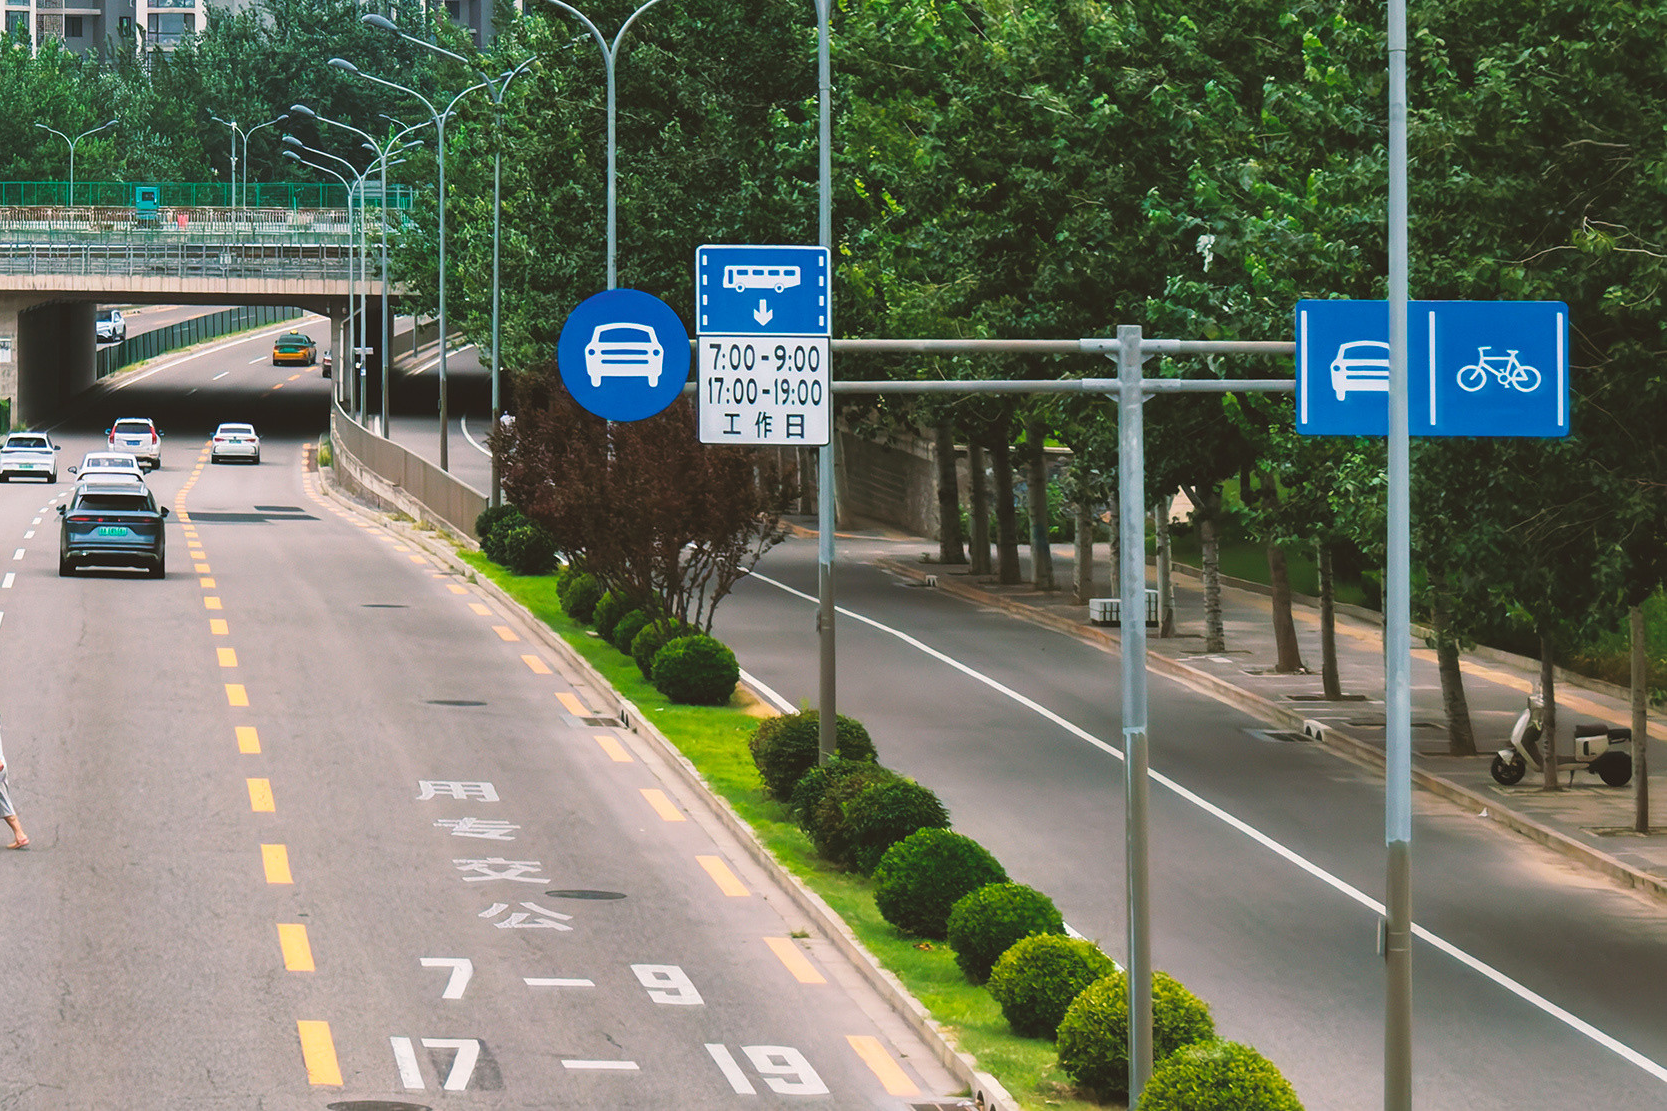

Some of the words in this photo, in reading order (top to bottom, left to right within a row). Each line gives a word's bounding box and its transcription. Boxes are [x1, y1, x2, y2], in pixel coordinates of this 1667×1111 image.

[709, 343, 820, 372] 7:00-9:00
[708, 377, 822, 406] 17:00-19:00
[723, 412, 805, 439] 工作日
[419, 957, 474, 1000] 7
[630, 963, 706, 1006] 9
[389, 1036, 481, 1091] 17
[704, 1042, 831, 1095] 19
